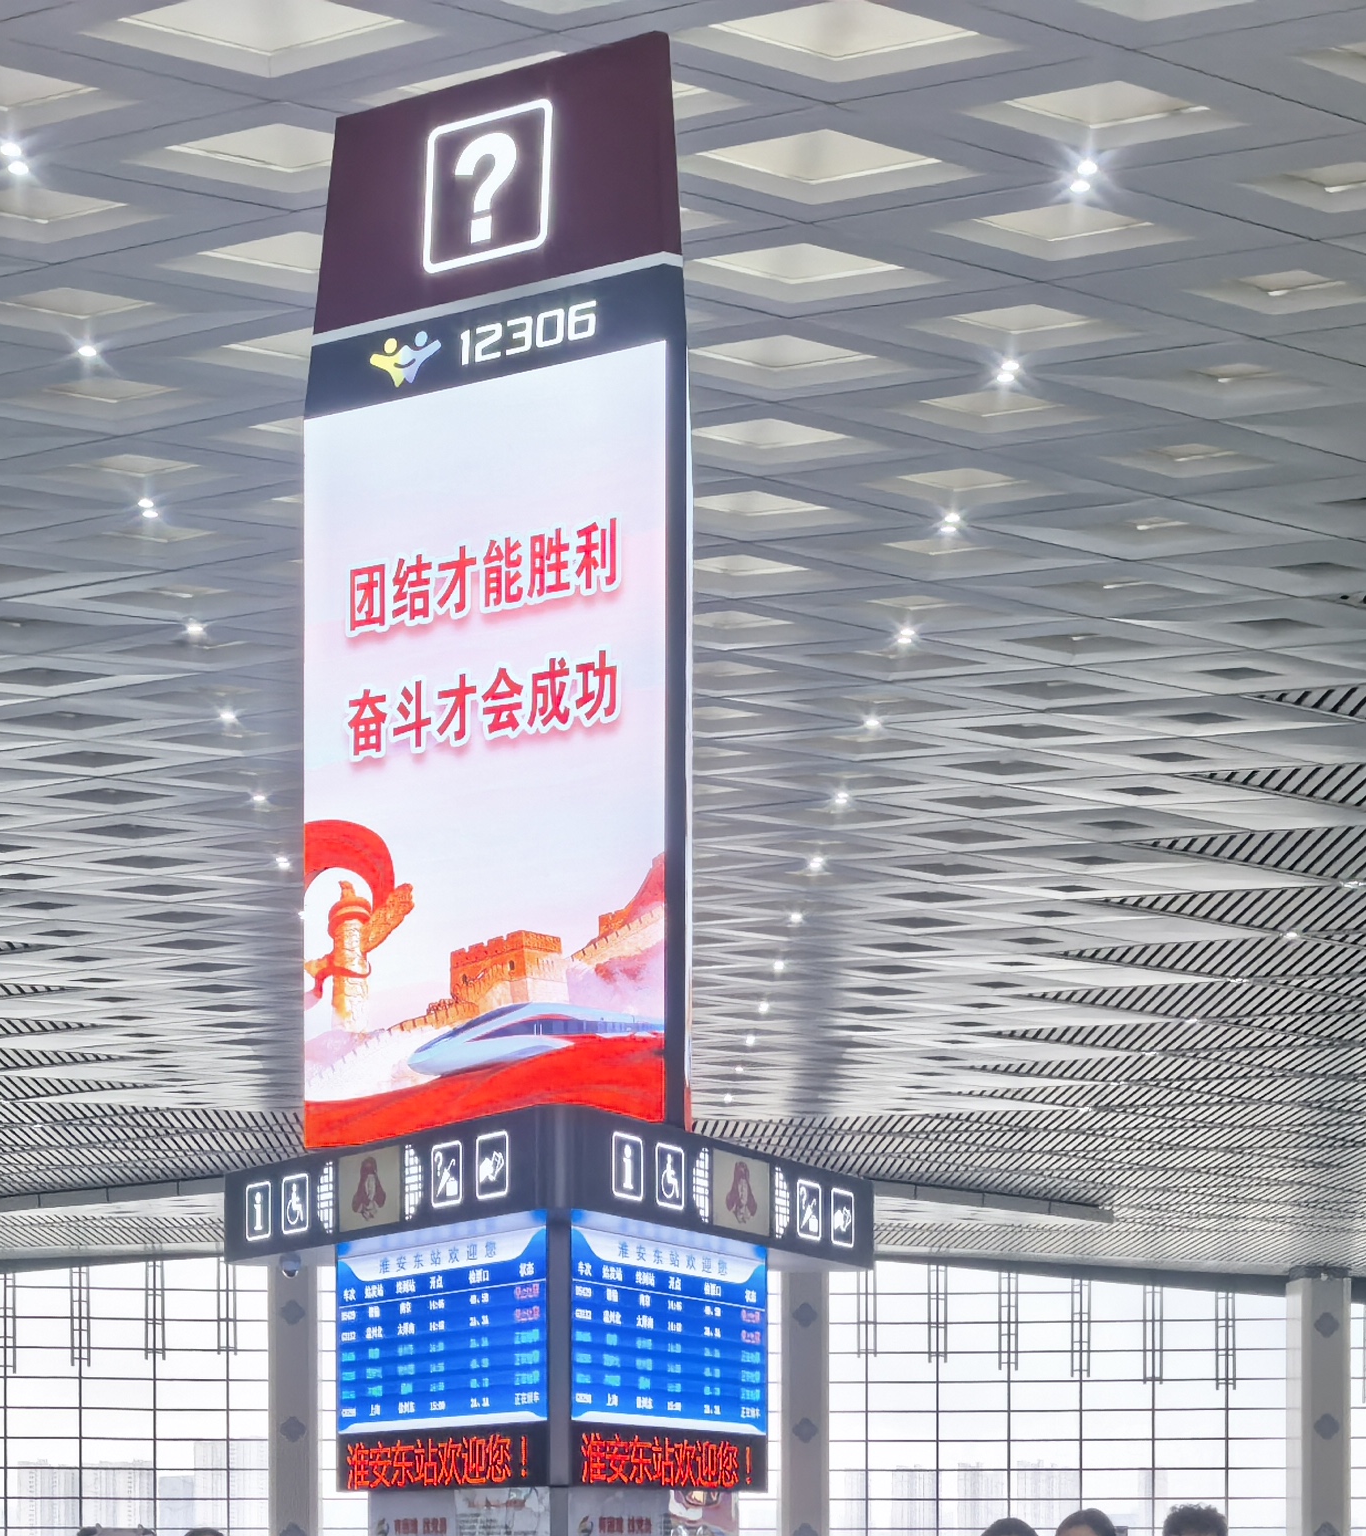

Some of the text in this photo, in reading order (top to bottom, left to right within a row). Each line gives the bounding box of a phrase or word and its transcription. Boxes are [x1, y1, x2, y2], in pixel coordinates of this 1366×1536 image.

[460, 300, 597, 366] 12306
[348, 516, 618, 632] 团结才能胜利
[346, 650, 618, 757] 奋斗才会成功
[379, 1241, 498, 1275] 淮安东站欢迎您
[618, 1241, 728, 1277] 淮安东站欢迎您
